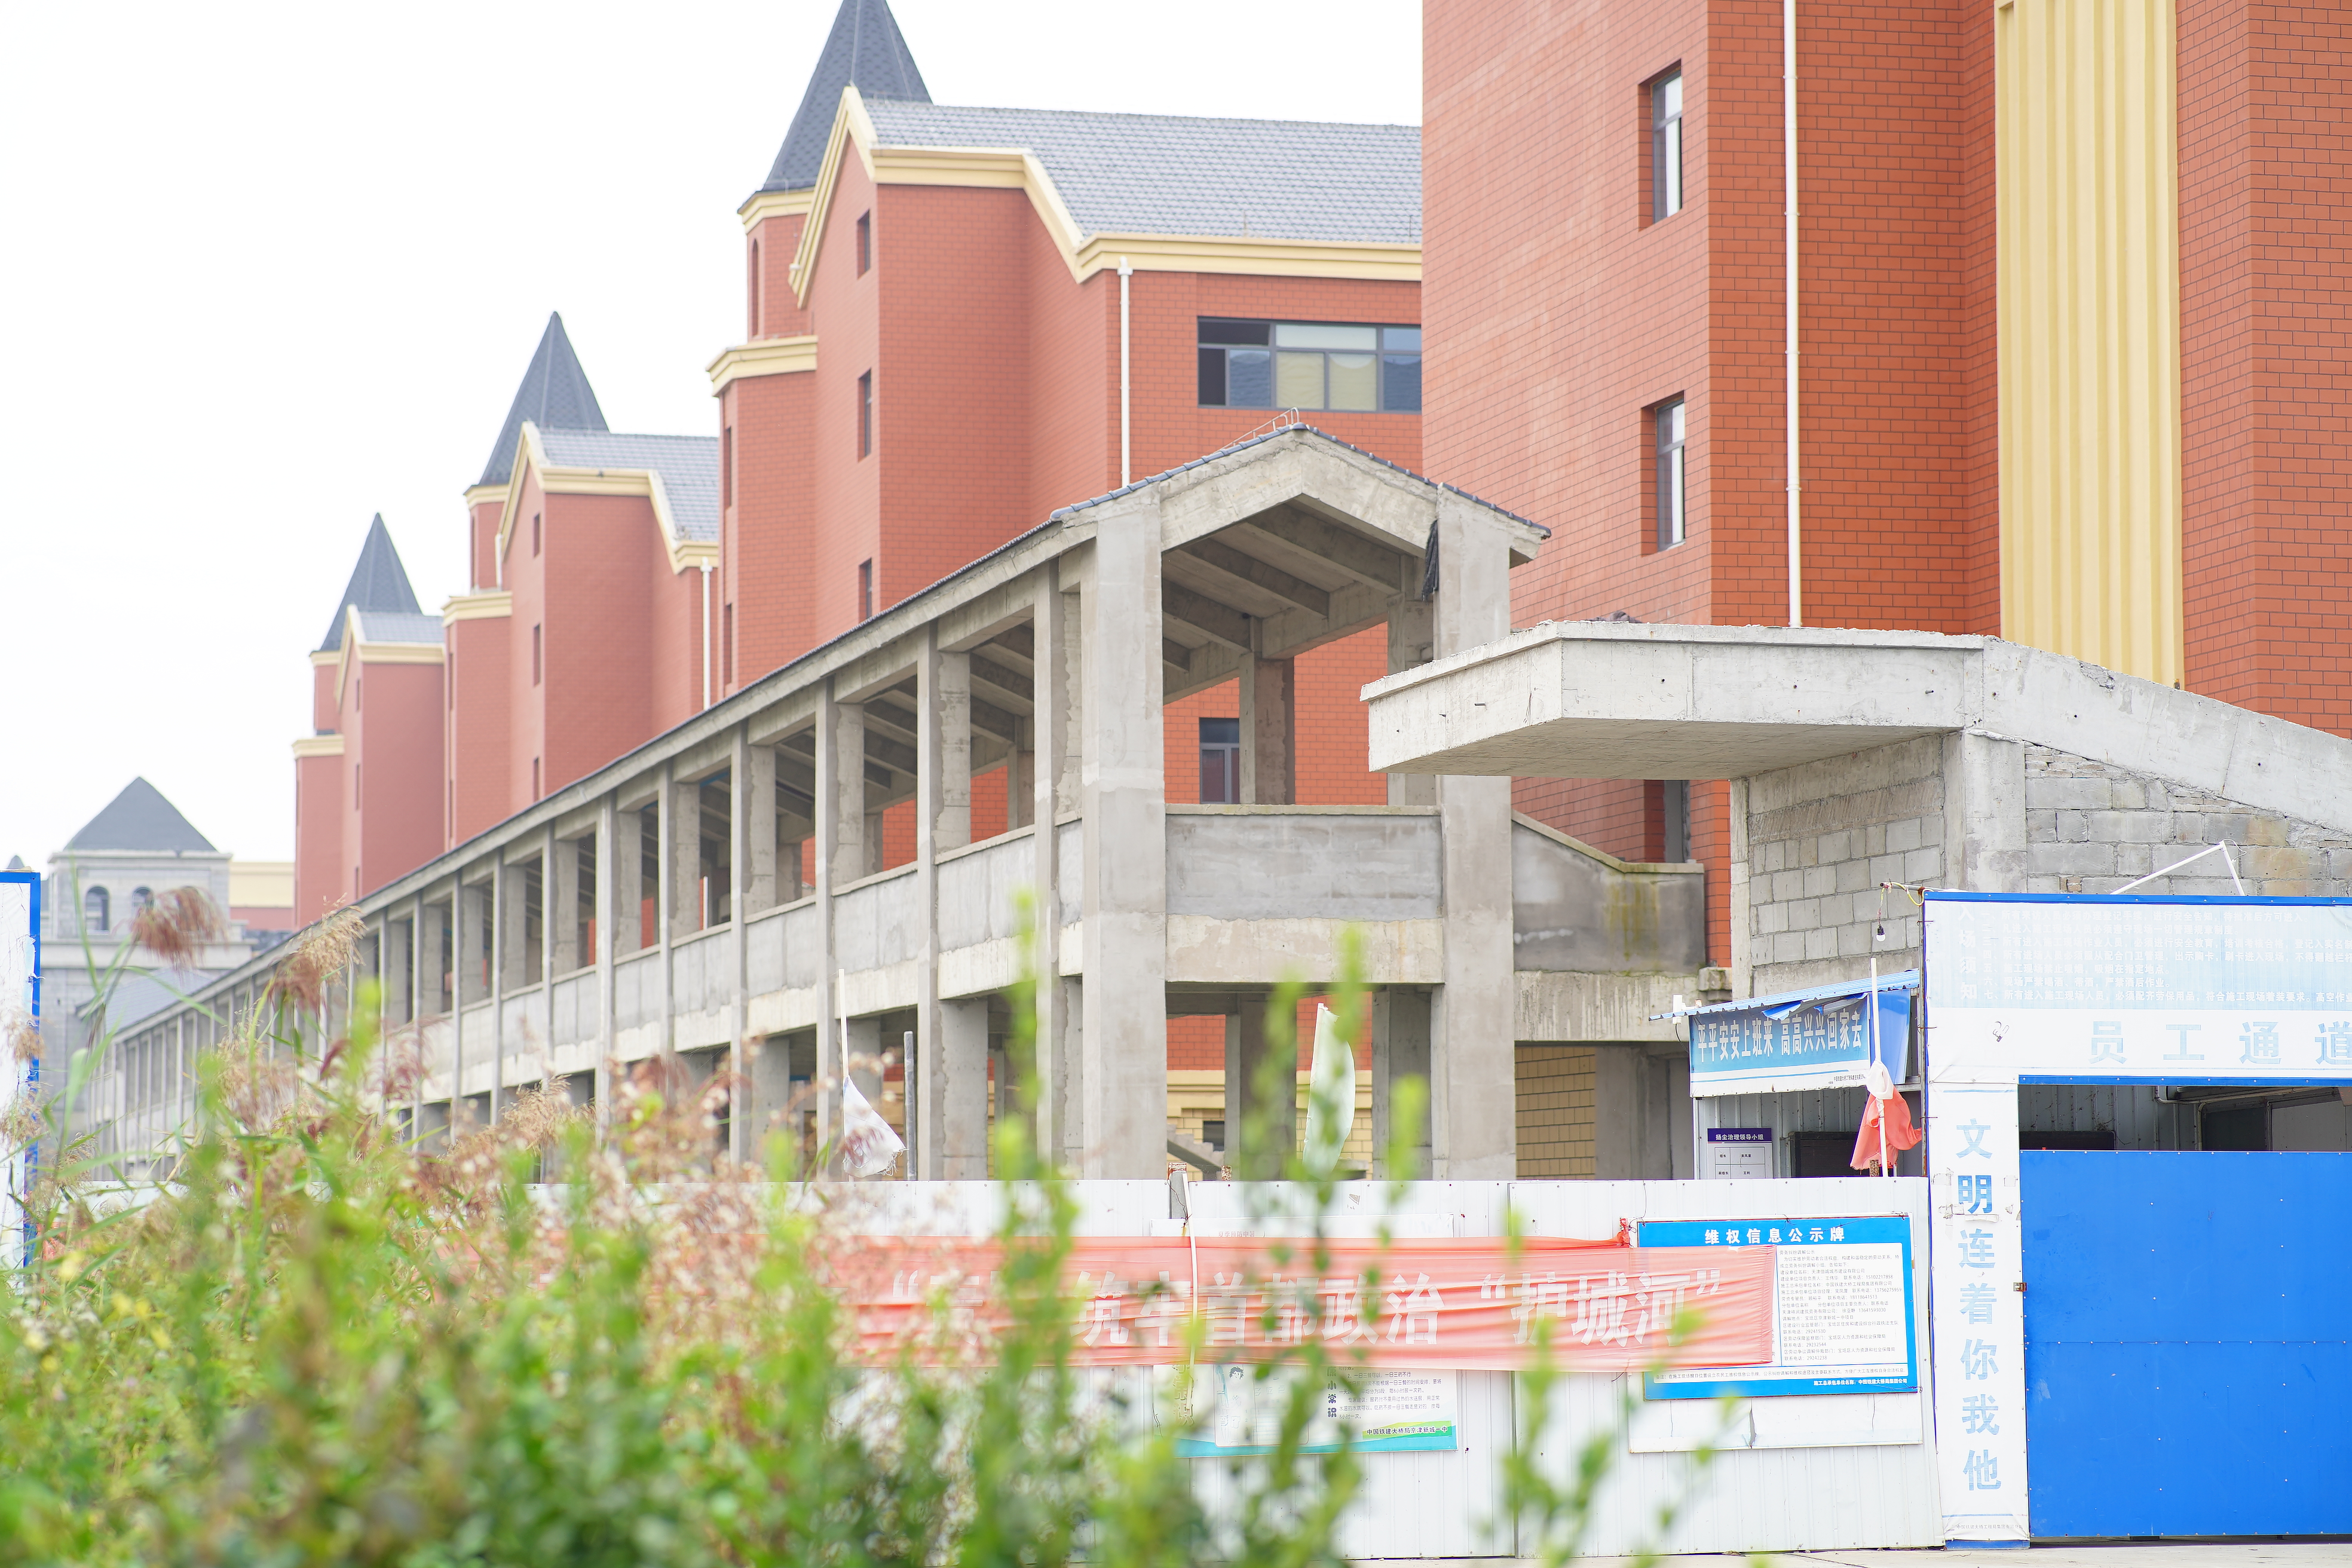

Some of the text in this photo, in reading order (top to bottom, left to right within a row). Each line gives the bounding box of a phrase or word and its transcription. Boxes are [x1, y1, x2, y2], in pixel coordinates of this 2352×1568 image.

[1957, 904, 1978, 1001] 入场须知
[1698, 1007, 1862, 1062] 平平安安上班来 高高兴兴回家去
[2088, 1020, 2352, 1065] 员工通道
[1704, 1226, 1845, 1245] 维权信息公示牌
[1955, 1117, 2002, 1492] 文明连着你我他
